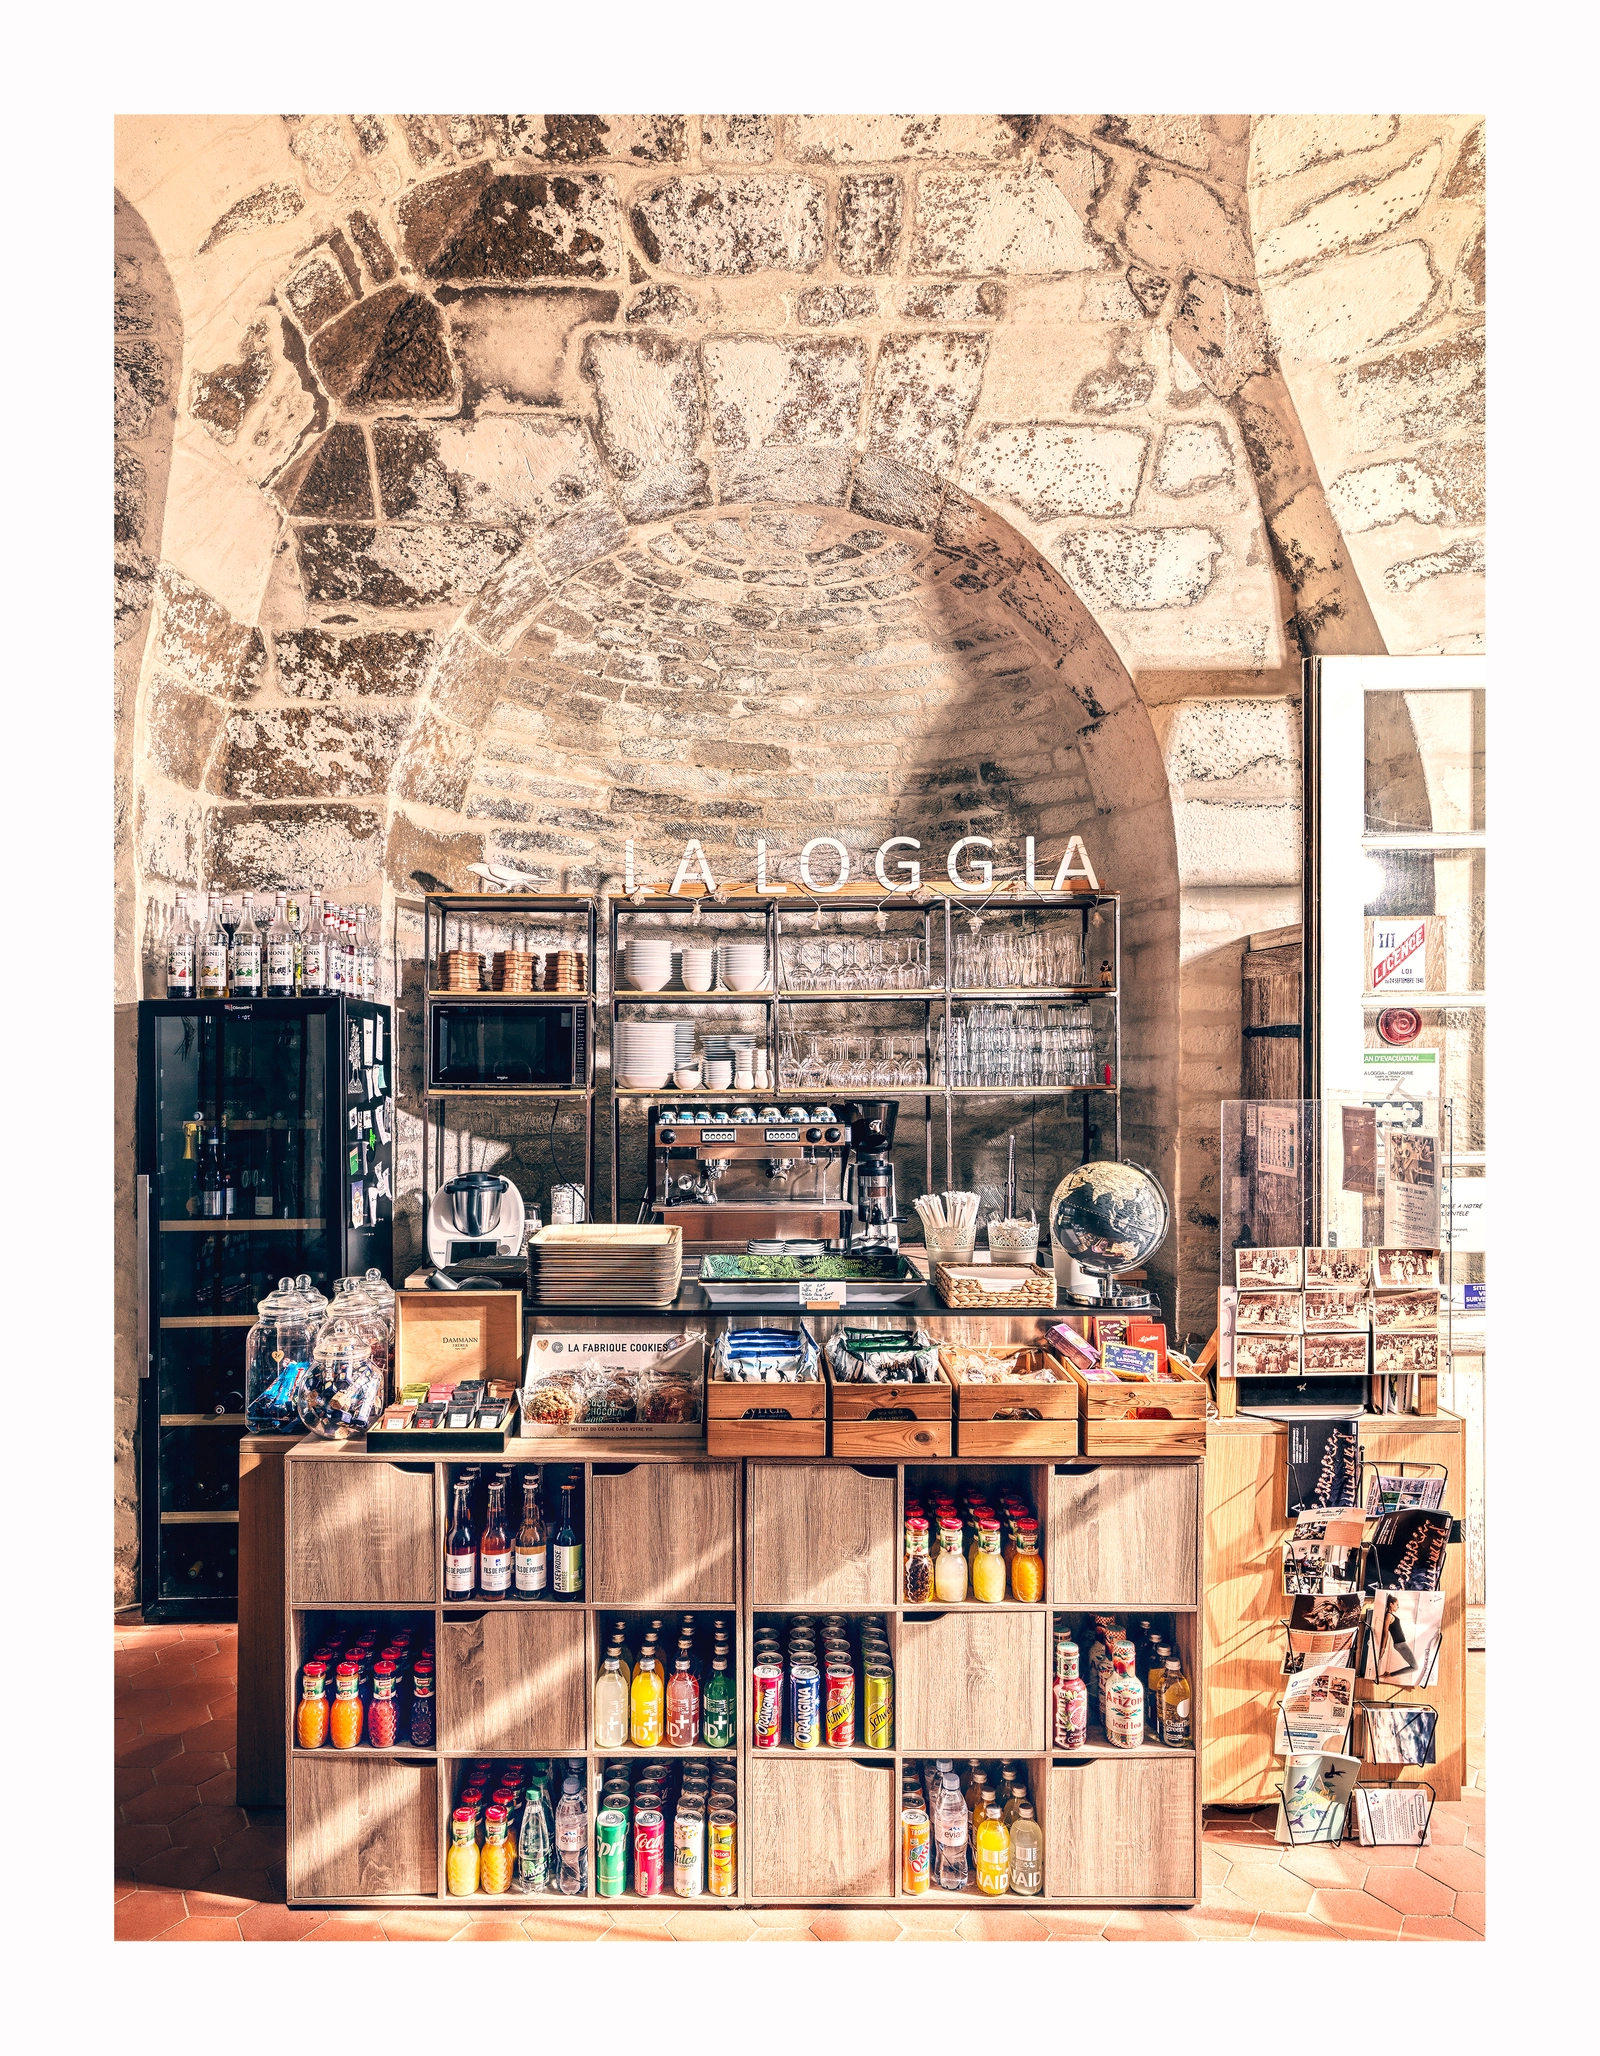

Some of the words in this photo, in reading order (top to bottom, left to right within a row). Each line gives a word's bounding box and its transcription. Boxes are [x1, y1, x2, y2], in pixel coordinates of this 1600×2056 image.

[626, 838, 717, 894] LA
[757, 836, 1100, 894] LOGGIA
[1374, 926, 1424, 984] LICENCE
[568, 1343, 580, 1353] LA
[583, 1343, 627, 1353] FABRIQUE
[630, 1343, 668, 1353] COOKIES
[586, 1407, 627, 1416] CHOCOLAT
[756, 1688, 777, 1735] ORANGINA
[795, 1687, 812, 1743] ORANGINA
[944, 1830, 965, 1838] evian
[673, 1844, 697, 1865] Pulco
